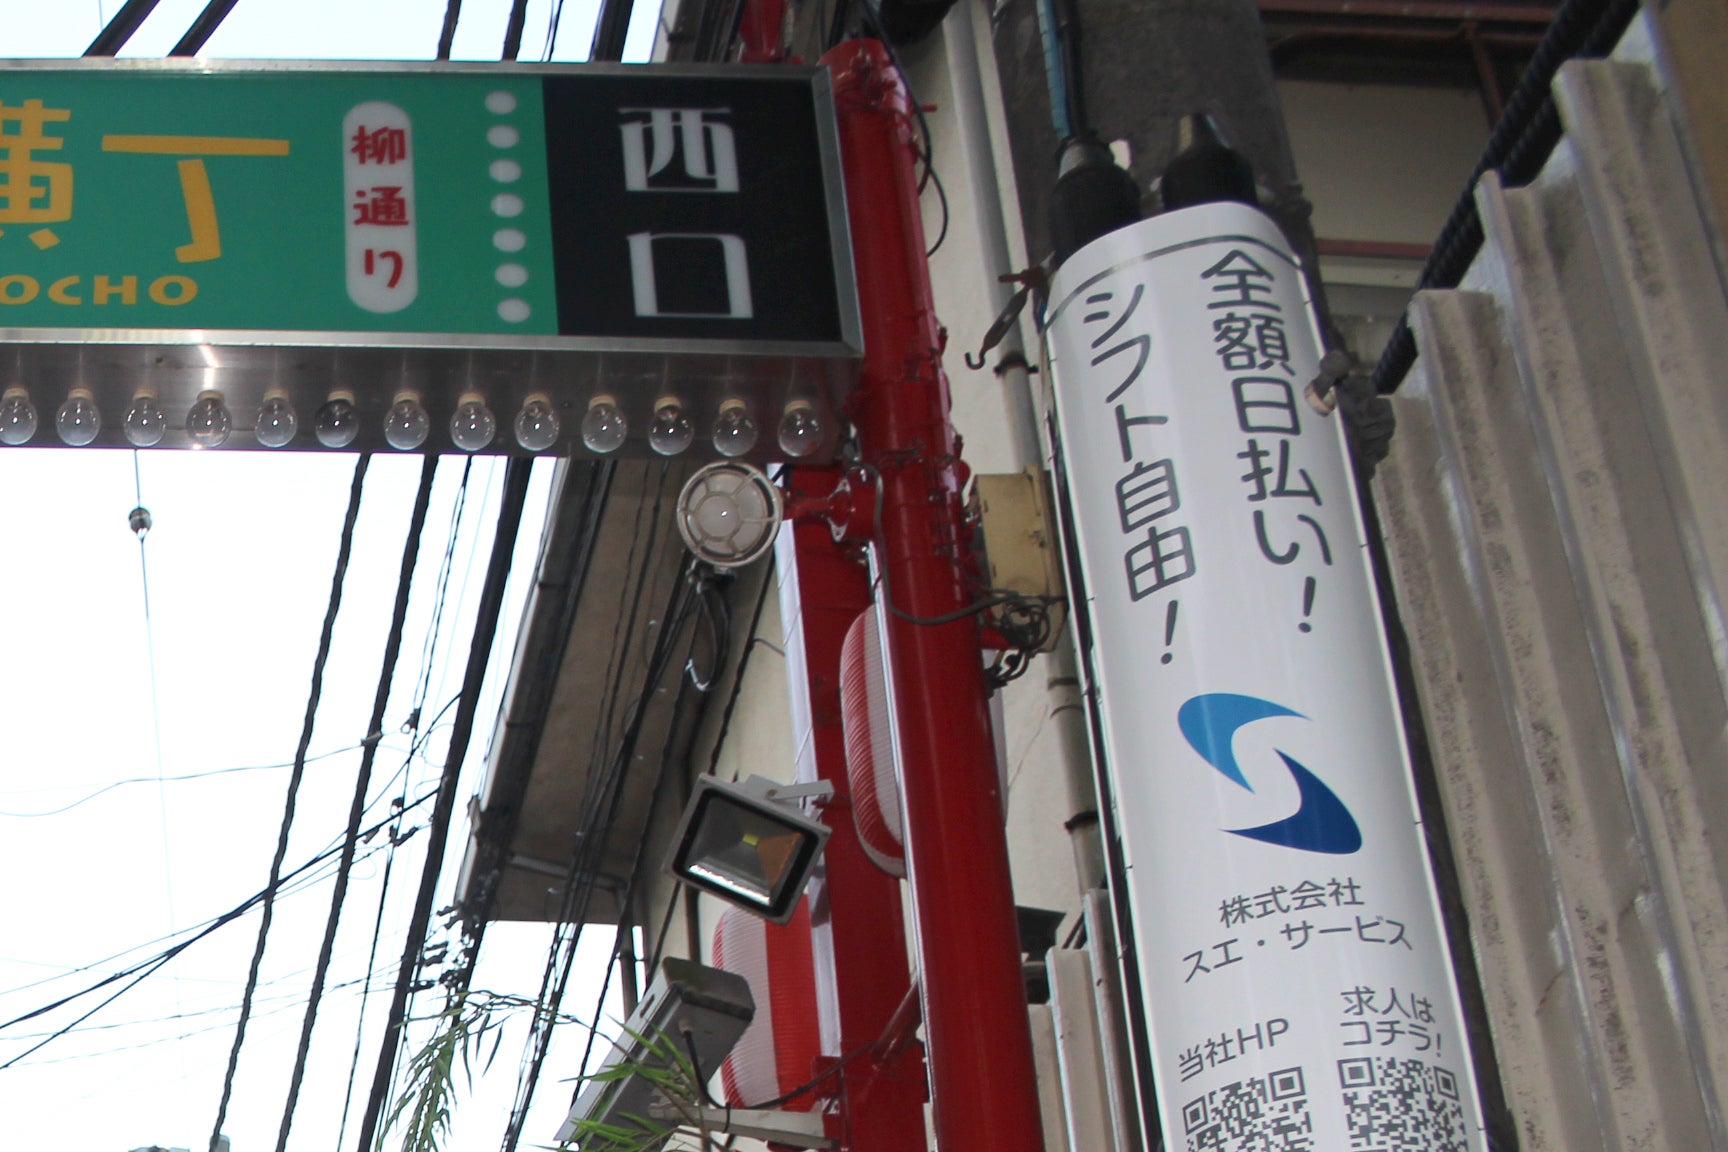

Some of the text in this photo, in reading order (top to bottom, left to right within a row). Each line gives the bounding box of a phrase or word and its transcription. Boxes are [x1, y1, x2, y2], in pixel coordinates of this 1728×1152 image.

[349, 123, 412, 289] 柳通り
[617, 106, 754, 319] 西口
[1218, 876, 1365, 930] 株式会社
[1182, 914, 1414, 983] スエ・サービス
[1339, 987, 1434, 1024] 求人は
[1177, 1017, 1291, 1084] 当社HP
